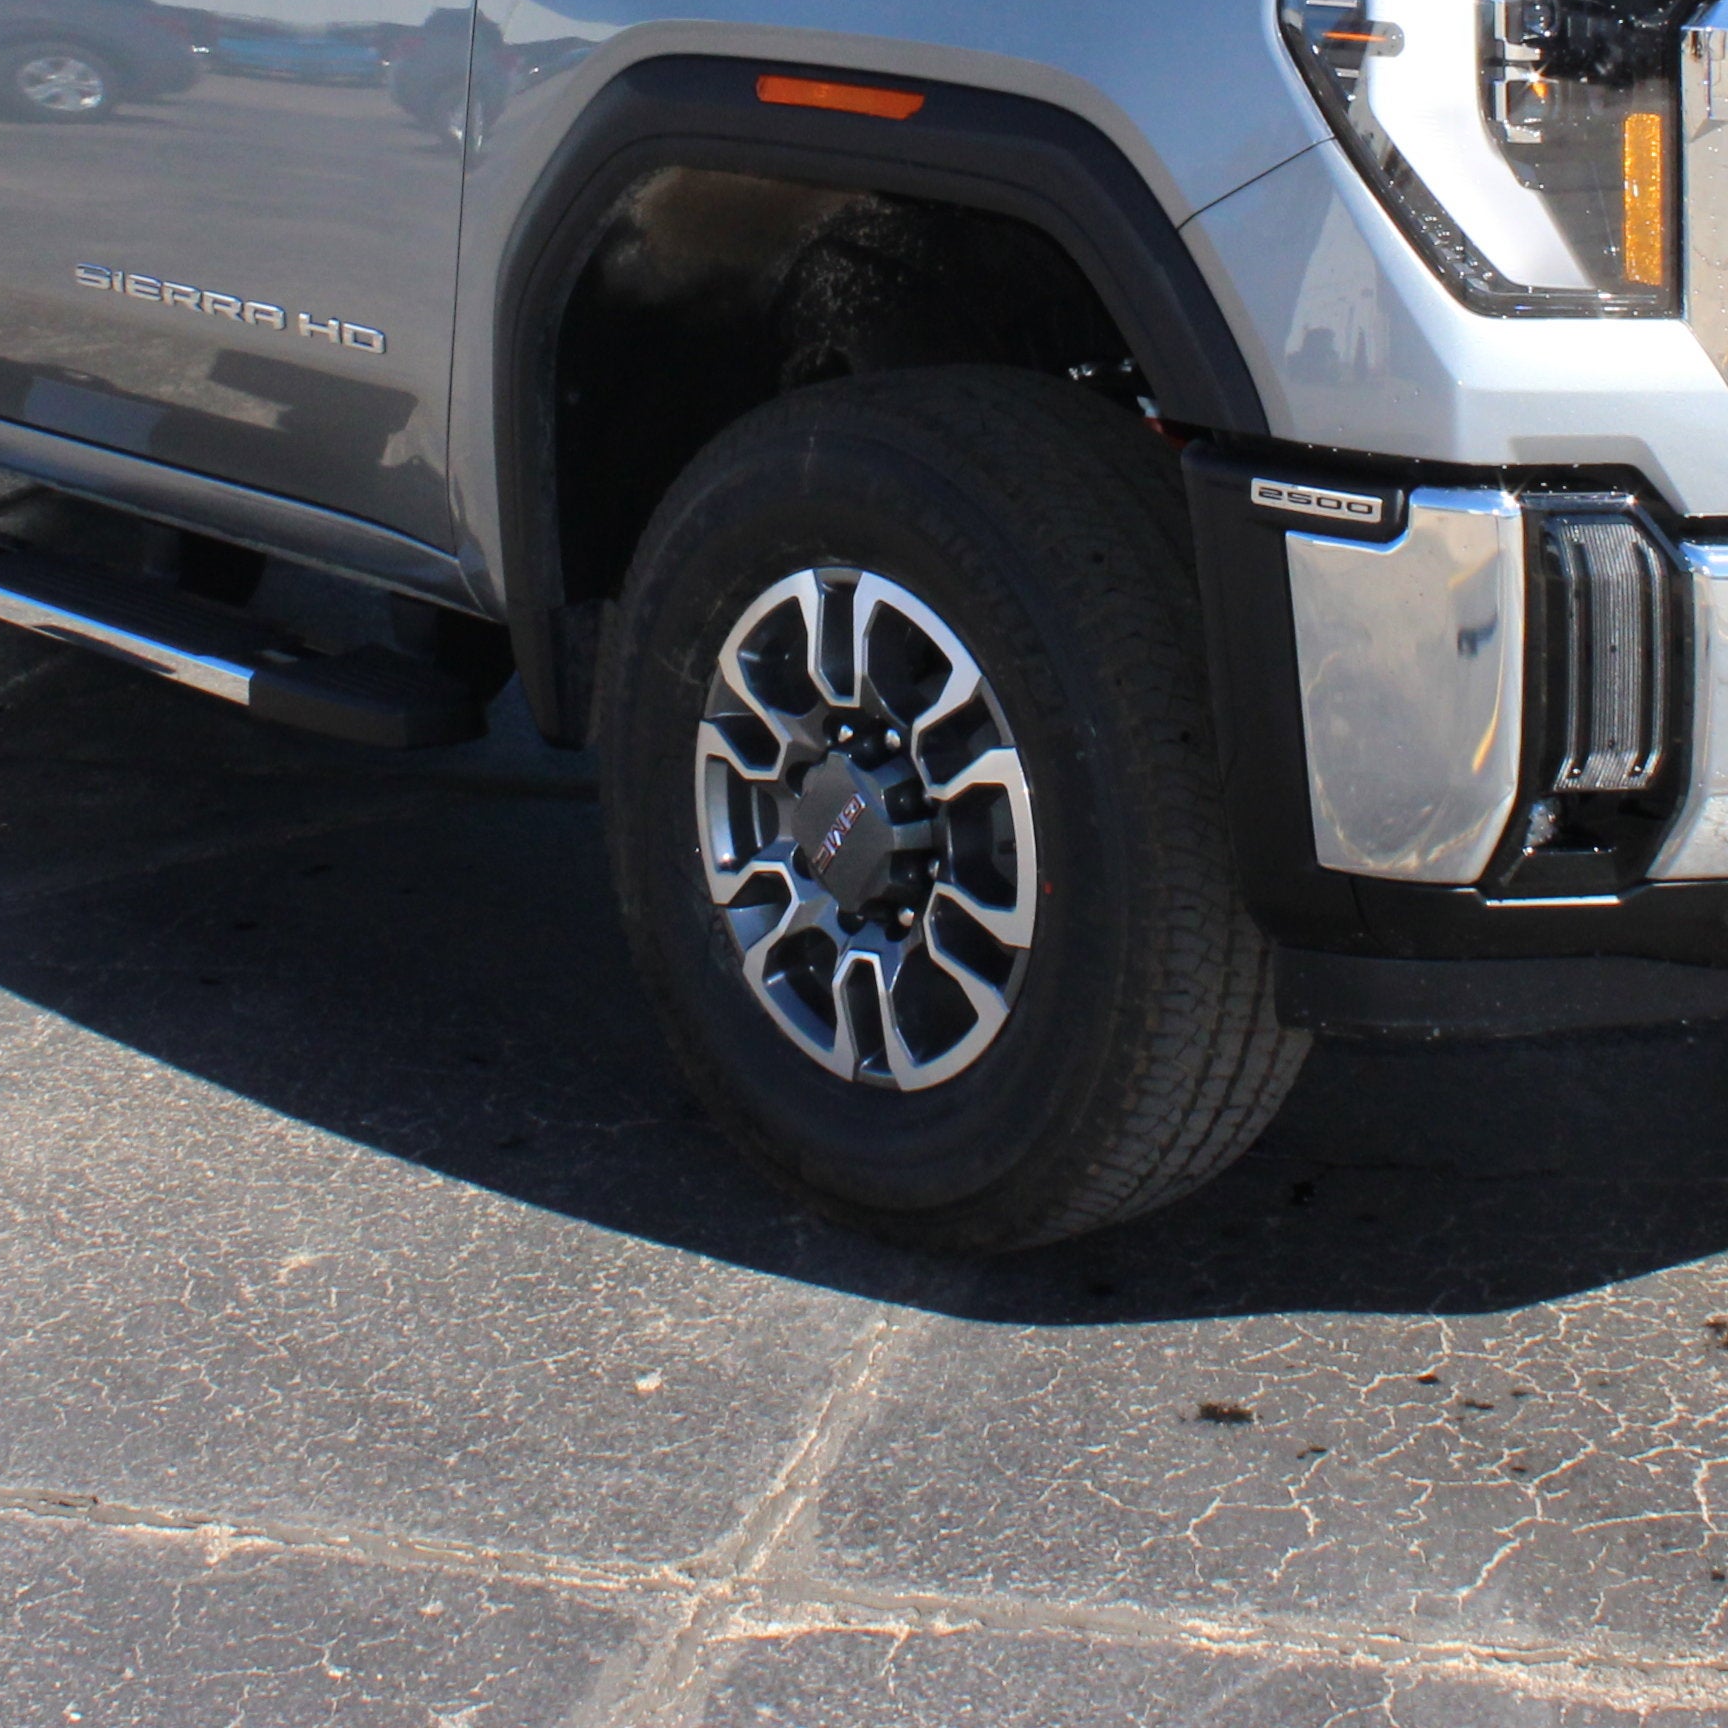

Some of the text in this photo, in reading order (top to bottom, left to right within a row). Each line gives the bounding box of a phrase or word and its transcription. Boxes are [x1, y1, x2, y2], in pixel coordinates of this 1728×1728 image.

[75, 263, 387, 354] SIERRA HD
[1258, 486, 1373, 515] 2500
[812, 793, 866, 874] GMC
